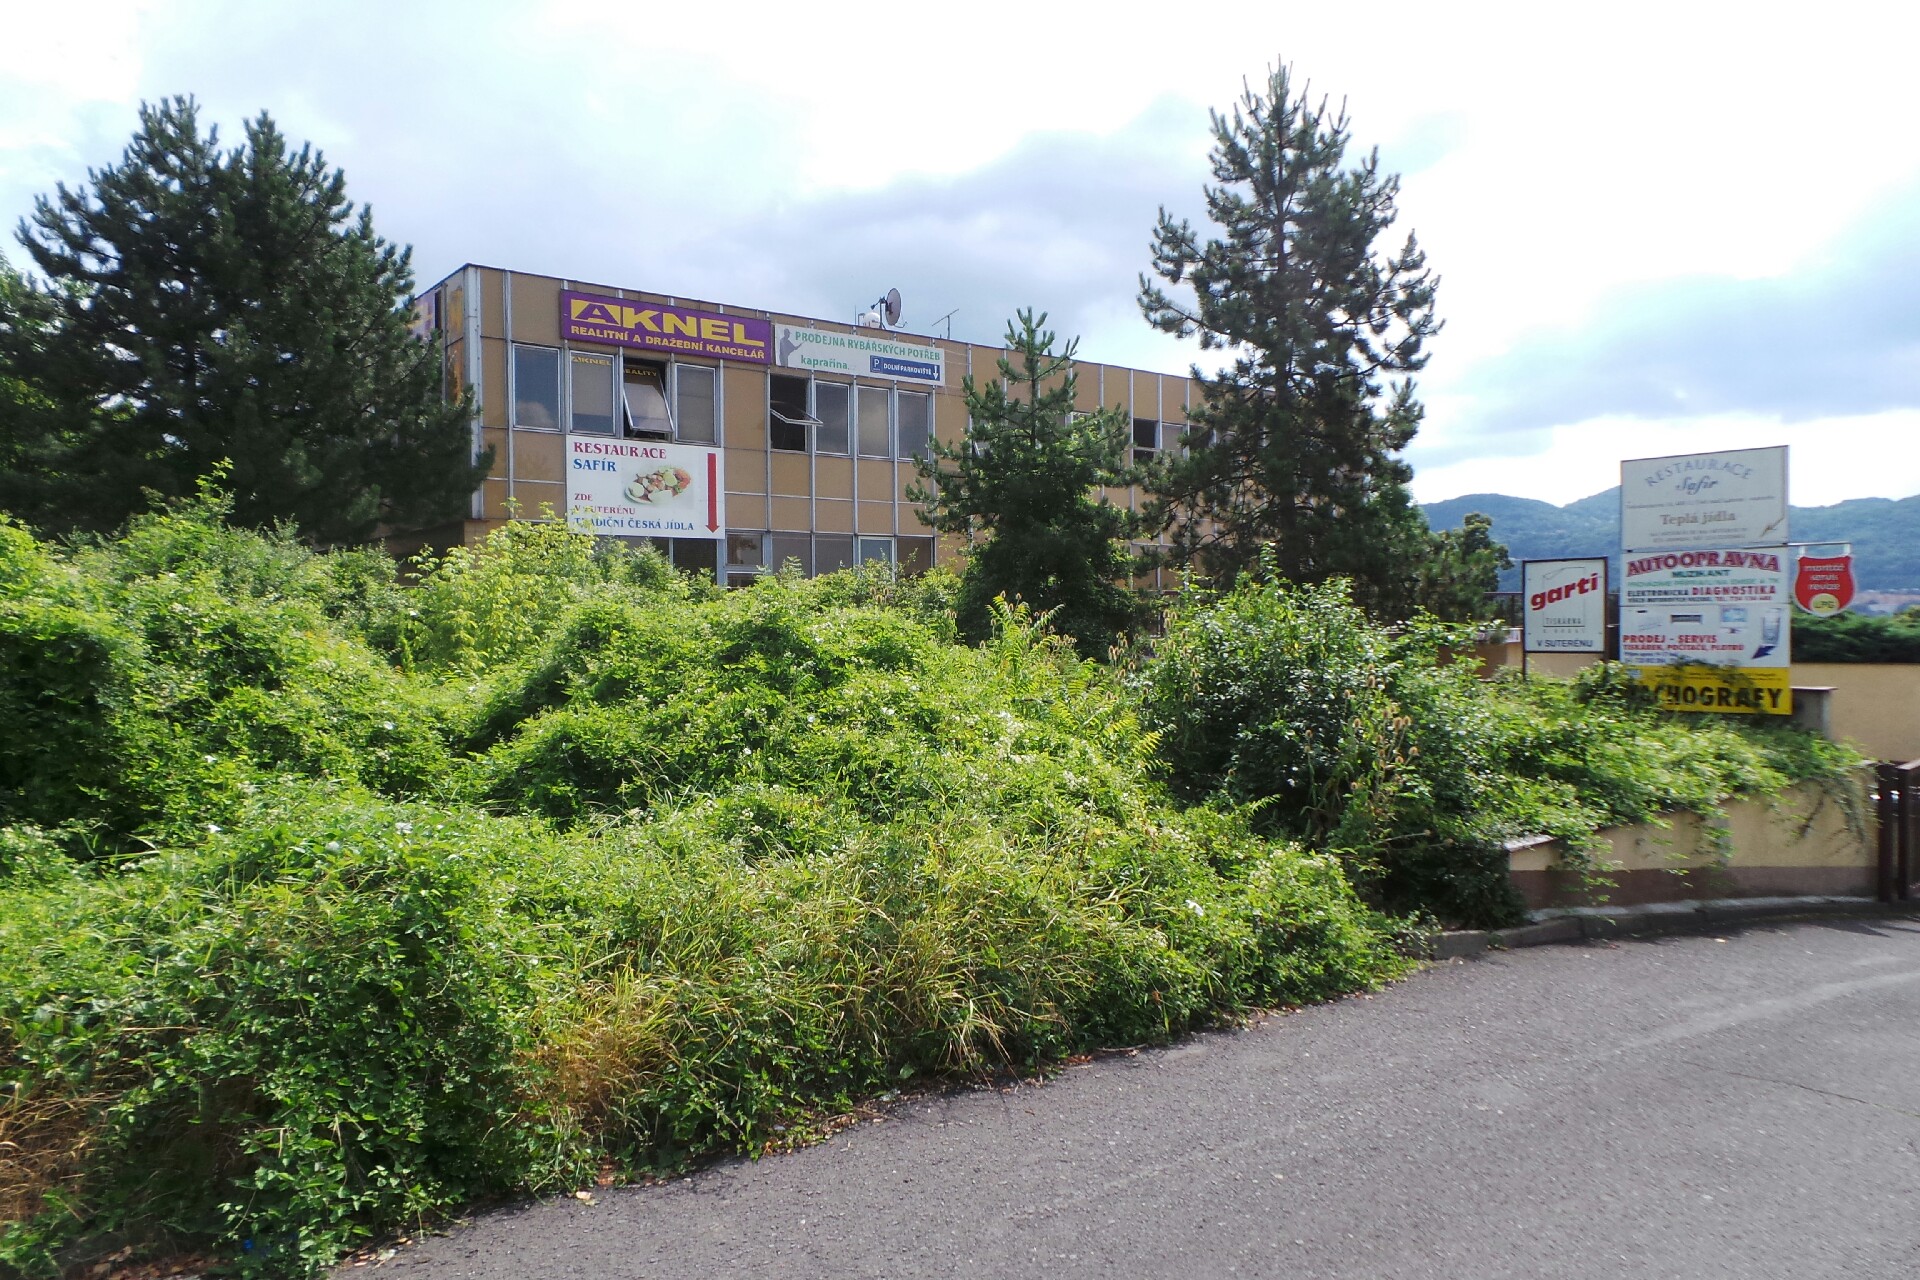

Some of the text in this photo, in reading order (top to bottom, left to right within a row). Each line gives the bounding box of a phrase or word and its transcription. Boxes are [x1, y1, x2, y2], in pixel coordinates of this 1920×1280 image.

[571, 299, 765, 347] AKNEL
[571, 325, 765, 359] REALITNÍ A DRAŽEBNÍ KANCELÁŘ
[795, 331, 941, 361] PRODEJNA RYBÁŘSKÝCH POTŘEB
[572, 356, 612, 366] AKNEL
[874, 359, 880, 368] P
[884, 363, 900, 371] DOLNÍ
[573, 442, 667, 459] RESTAURACE
[573, 458, 617, 472] SAFÍR
[1645, 458, 1754, 487] RESTAURACE
[574, 493, 593, 501] ZDE
[628, 518, 661, 529] ČESKÁ
[664, 520, 694, 531] JÍDLA
[1660, 510, 1736, 526] Teplá jídla
[1626, 550, 1781, 577] AUTOOPRAVNA
[1672, 569, 1732, 578] MUZIKANT
[1531, 572, 1599, 611] garti
[1692, 585, 1776, 596] DIAGNOSTIKA
[1623, 634, 1666, 643] PRODEJ
[1678, 634, 1718, 643] SERVIS
